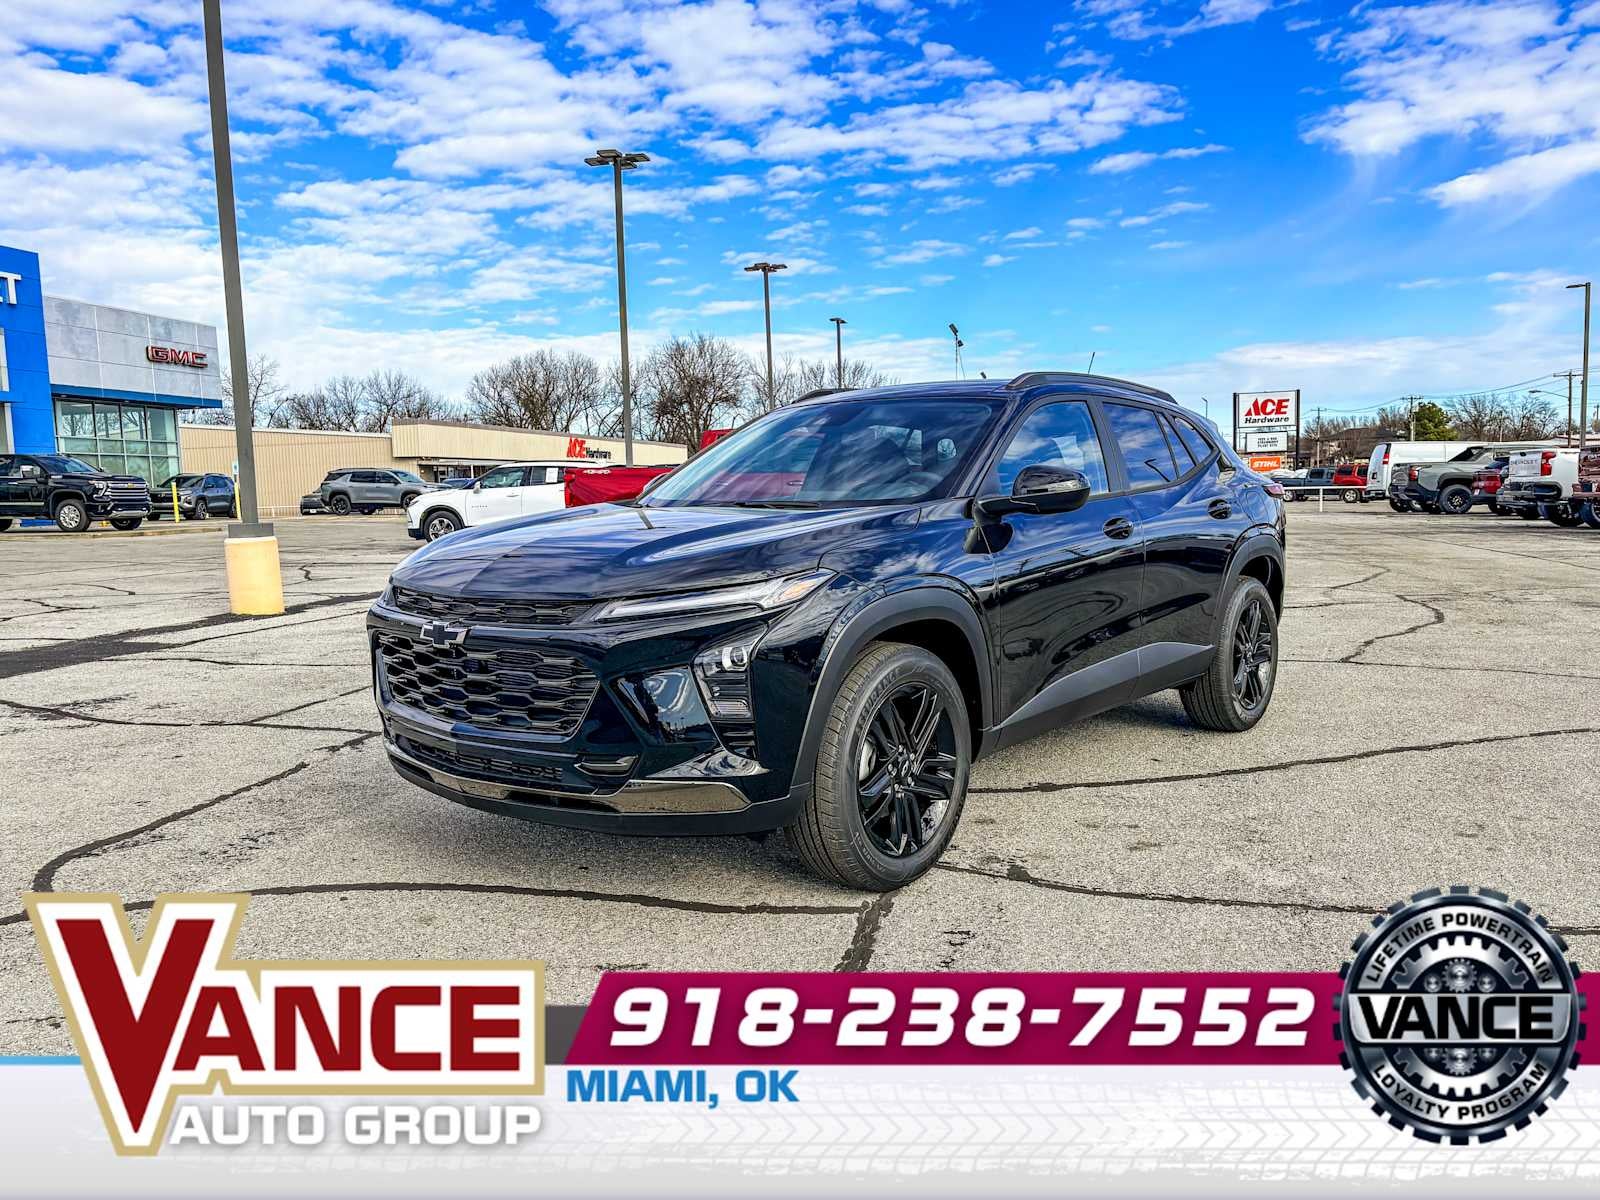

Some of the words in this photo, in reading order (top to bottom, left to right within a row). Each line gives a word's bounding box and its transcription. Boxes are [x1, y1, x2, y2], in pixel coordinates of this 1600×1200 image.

[146, 345, 208, 368] GMC
[1245, 398, 1290, 416] ACE
[1244, 416, 1290, 424] Hardware
[567, 436, 586, 458] ACE
[586, 447, 611, 459] Hardware
